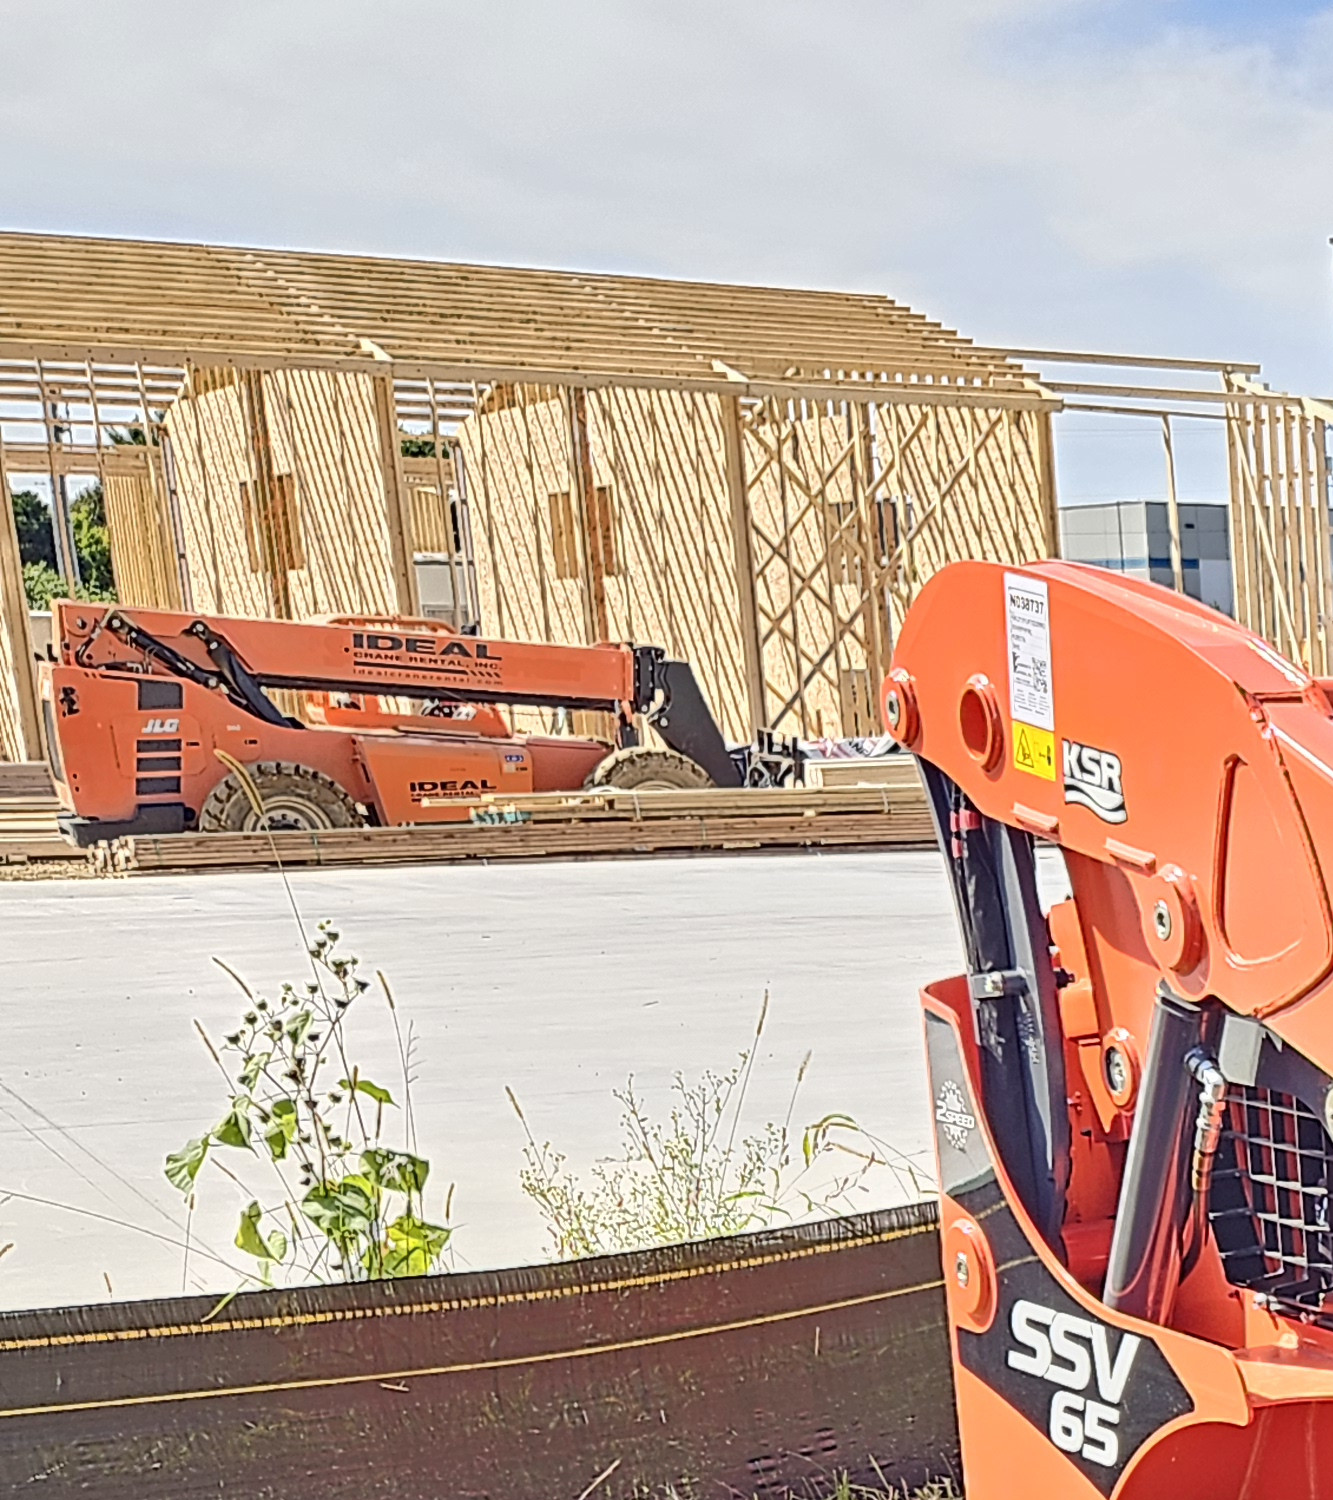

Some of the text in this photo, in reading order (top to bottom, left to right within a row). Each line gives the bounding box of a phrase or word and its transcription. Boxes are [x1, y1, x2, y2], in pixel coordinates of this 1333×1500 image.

[353, 634, 503, 660] IDEAL
[353, 652, 405, 661] CRANE
[141, 718, 180, 734] JLG
[1062, 739, 1123, 794] KSR
[410, 780, 497, 793] IDEAL
[1007, 1299, 1140, 1405] SSV
[1050, 1390, 1120, 1468] 65
